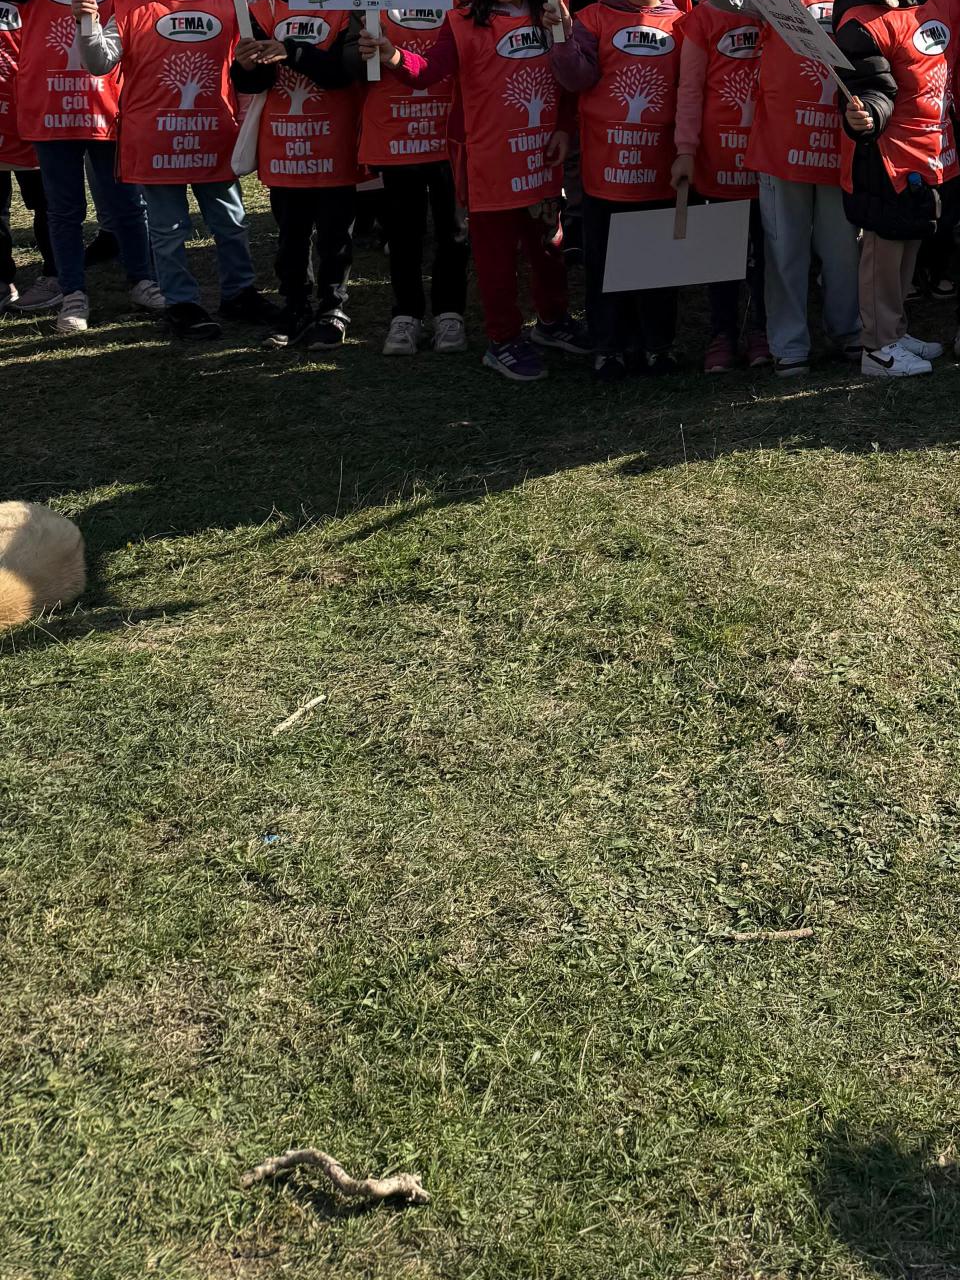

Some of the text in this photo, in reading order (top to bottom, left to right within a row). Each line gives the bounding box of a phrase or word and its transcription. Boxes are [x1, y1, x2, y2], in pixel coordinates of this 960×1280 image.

[401, 9, 435, 18] TEMA
[171, 16, 204, 31] TEMA
[285, 22, 315, 36] TEMA
[508, 29, 540, 45] TEMA
[626, 30, 658, 46] TEMA
[920, 24, 945, 43] TEMA
[47, 74, 105, 92] TÜRKİYE
[62, 93, 90, 110] ÇÖL
[44, 111, 107, 128] OLMASIN
[156, 113, 219, 132] TÜRKİYE
[270, 118, 330, 137] TÜRKİYE
[407, 119, 437, 136] ÇÖL
[172, 134, 201, 150] ÇÖL
[607, 126, 661, 146] TÜRKİYE
[809, 130, 835, 149] ÇÖL
[285, 138, 313, 156] ÇÖL
[152, 153, 218, 169] OLMASIN
[618, 146, 642, 167] ÇÖL
[270, 158, 333, 174] OLMASIN
[603, 168, 657, 184] OLMASIN
